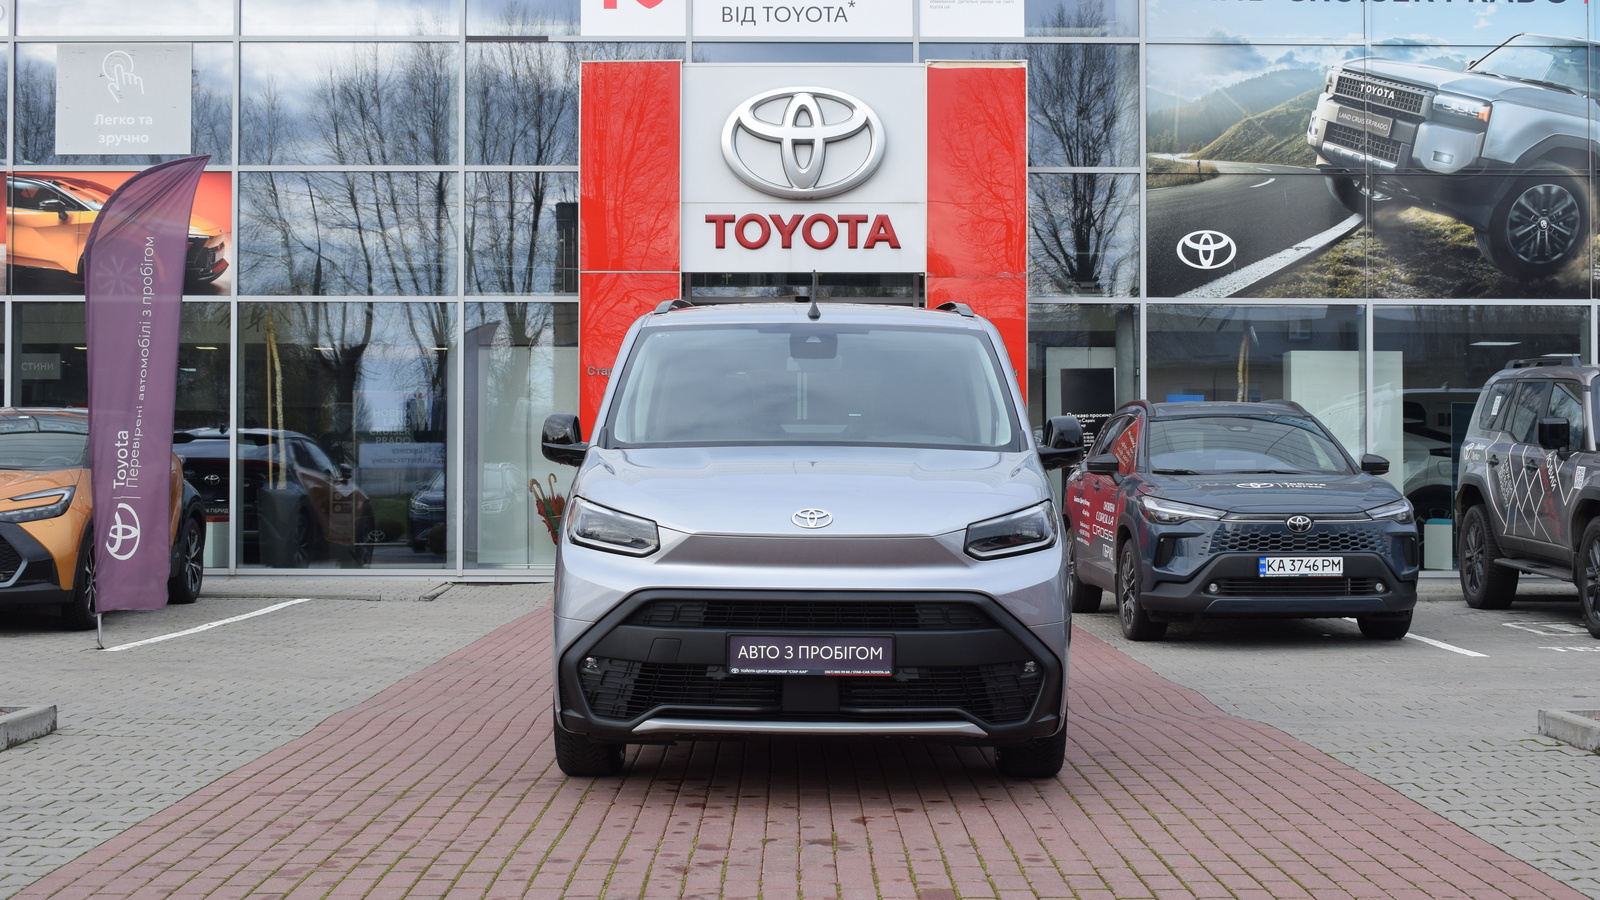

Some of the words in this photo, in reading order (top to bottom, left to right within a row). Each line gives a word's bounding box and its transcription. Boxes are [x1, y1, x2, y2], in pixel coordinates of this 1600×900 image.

[721, 6, 756, 26] ВІД
[1360, 83, 1395, 99] TOYOTA
[94, 114, 135, 125] Легко
[138, 116, 153, 125] та
[1338, 112, 1351, 121] LAND
[1351, 115, 1372, 126] CRUISER
[1371, 120, 1388, 131] PRADO
[98, 134, 149, 146] зручно
[705, 213, 902, 250] TOYOTA
[140, 236, 155, 305] пробігом
[21, 362, 54, 371] СТИНИ
[138, 321, 151, 401] автомобілі
[383, 418, 411, 426] LAND
[369, 427, 411, 436] CRUISER
[126, 405, 144, 488] Перевірені
[375, 436, 411, 445] PRADO
[113, 430, 129, 489] Toyota
[1096, 511, 1114, 526] COROLLA
[1092, 523, 1114, 542] CROSS
[1267, 559, 1286, 572] KA
[1289, 559, 1319, 572] 3746
[1322, 559, 1341, 572] PM
[738, 645, 779, 659] АВТО
[798, 645, 883, 661] ПРОБІГОМ
